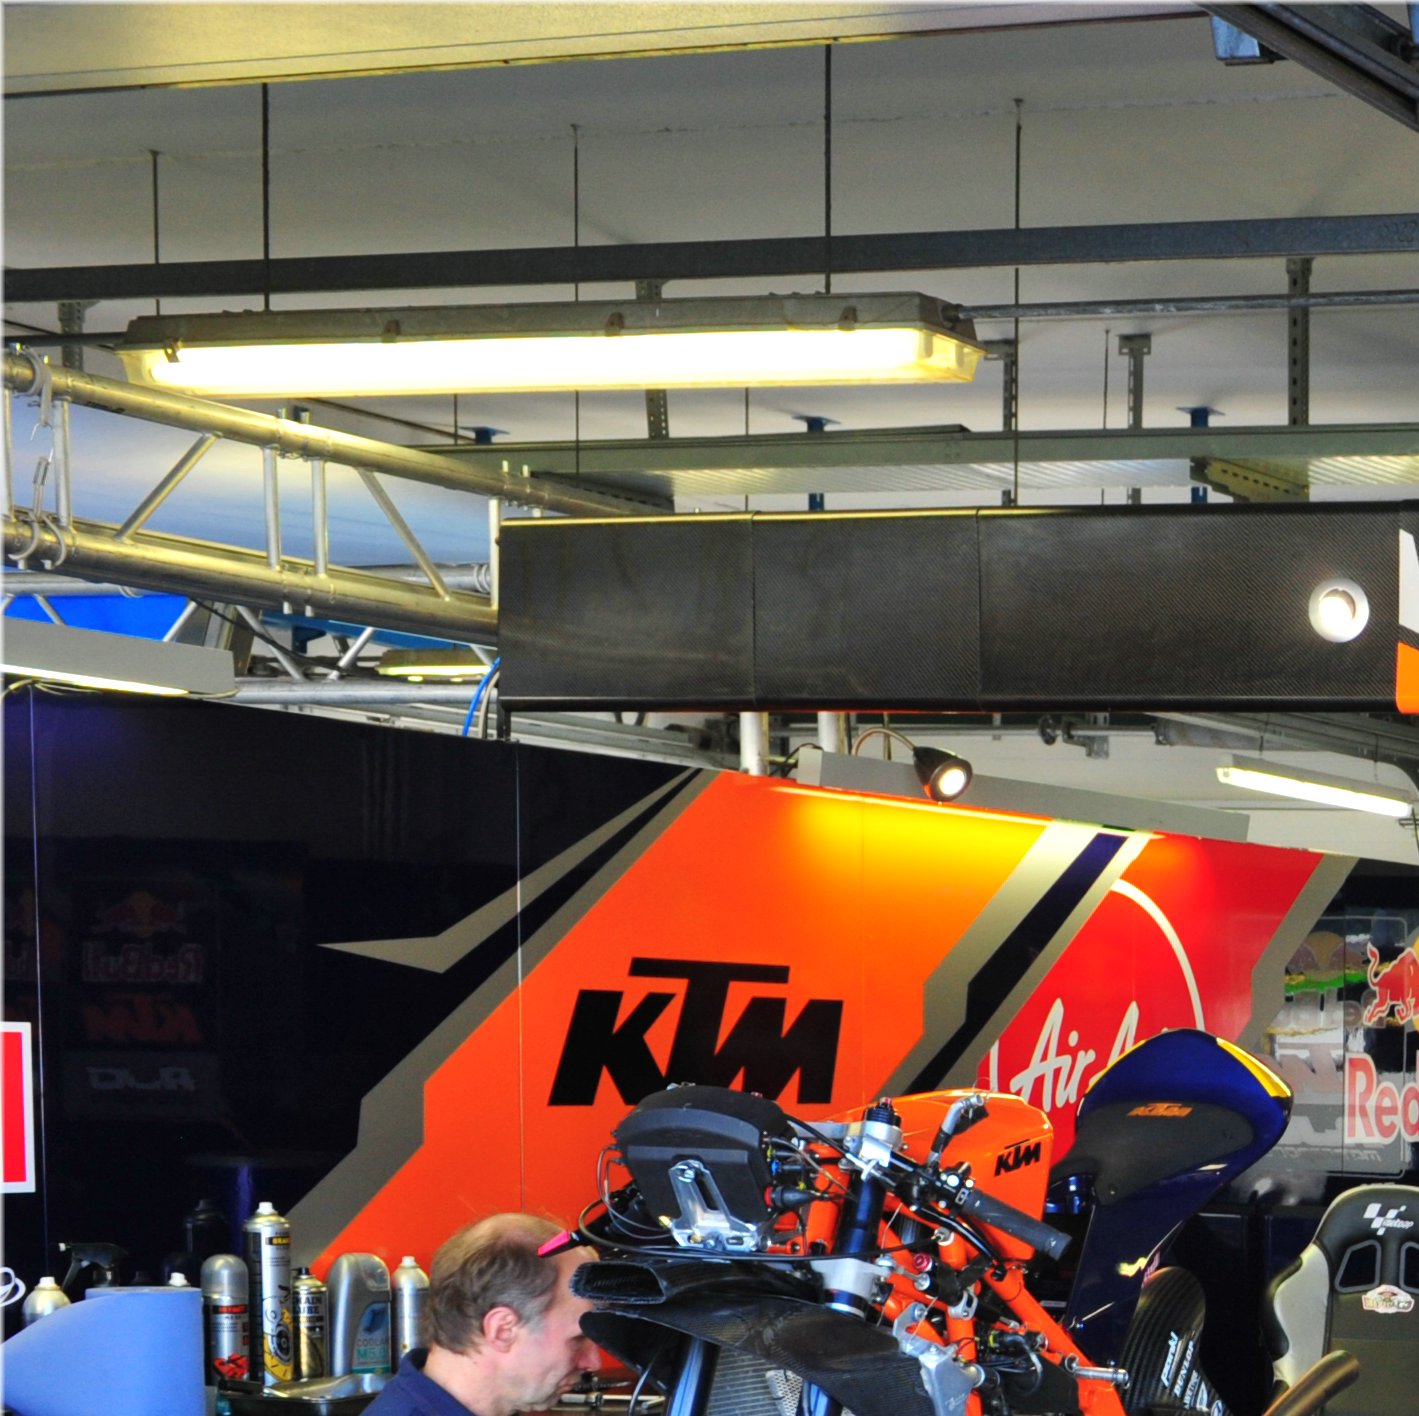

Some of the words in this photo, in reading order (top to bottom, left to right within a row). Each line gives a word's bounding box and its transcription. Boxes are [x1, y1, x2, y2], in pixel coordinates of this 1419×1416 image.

[548, 957, 843, 1106] KTM
[994, 1138, 1042, 1178] KTM
[1173, 1339, 1195, 1398] DUNLOP
